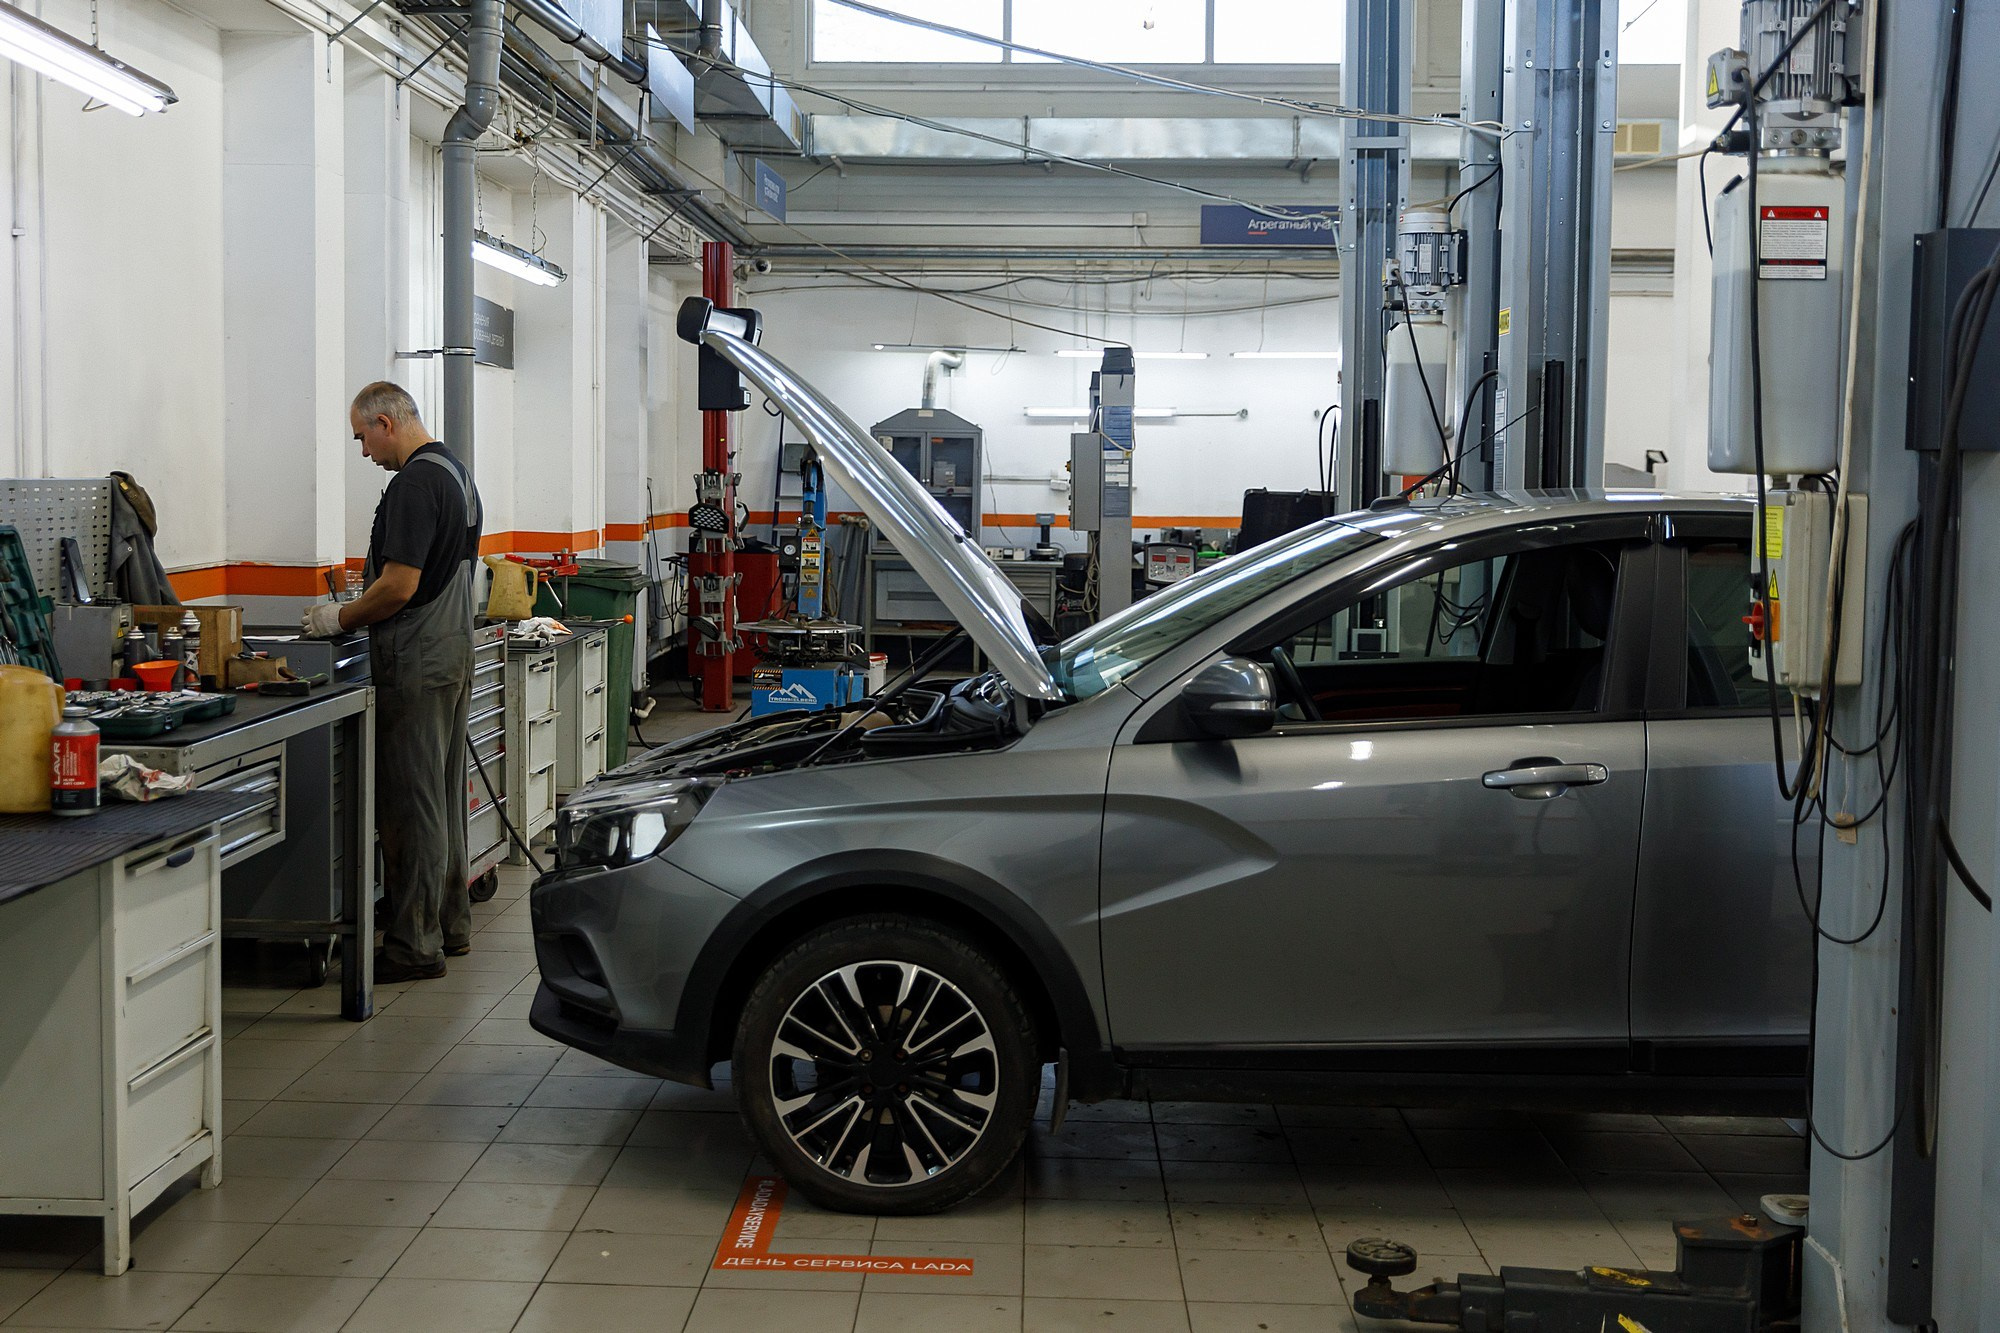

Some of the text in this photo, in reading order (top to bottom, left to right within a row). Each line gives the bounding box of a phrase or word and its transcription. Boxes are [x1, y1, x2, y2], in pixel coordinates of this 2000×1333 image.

[1247, 219, 1332, 232] Агрегатный уча
[53, 743, 61, 785] LAVR
[722, 1257, 972, 1271] ДЕНЬ СЕРВИСА LADA
